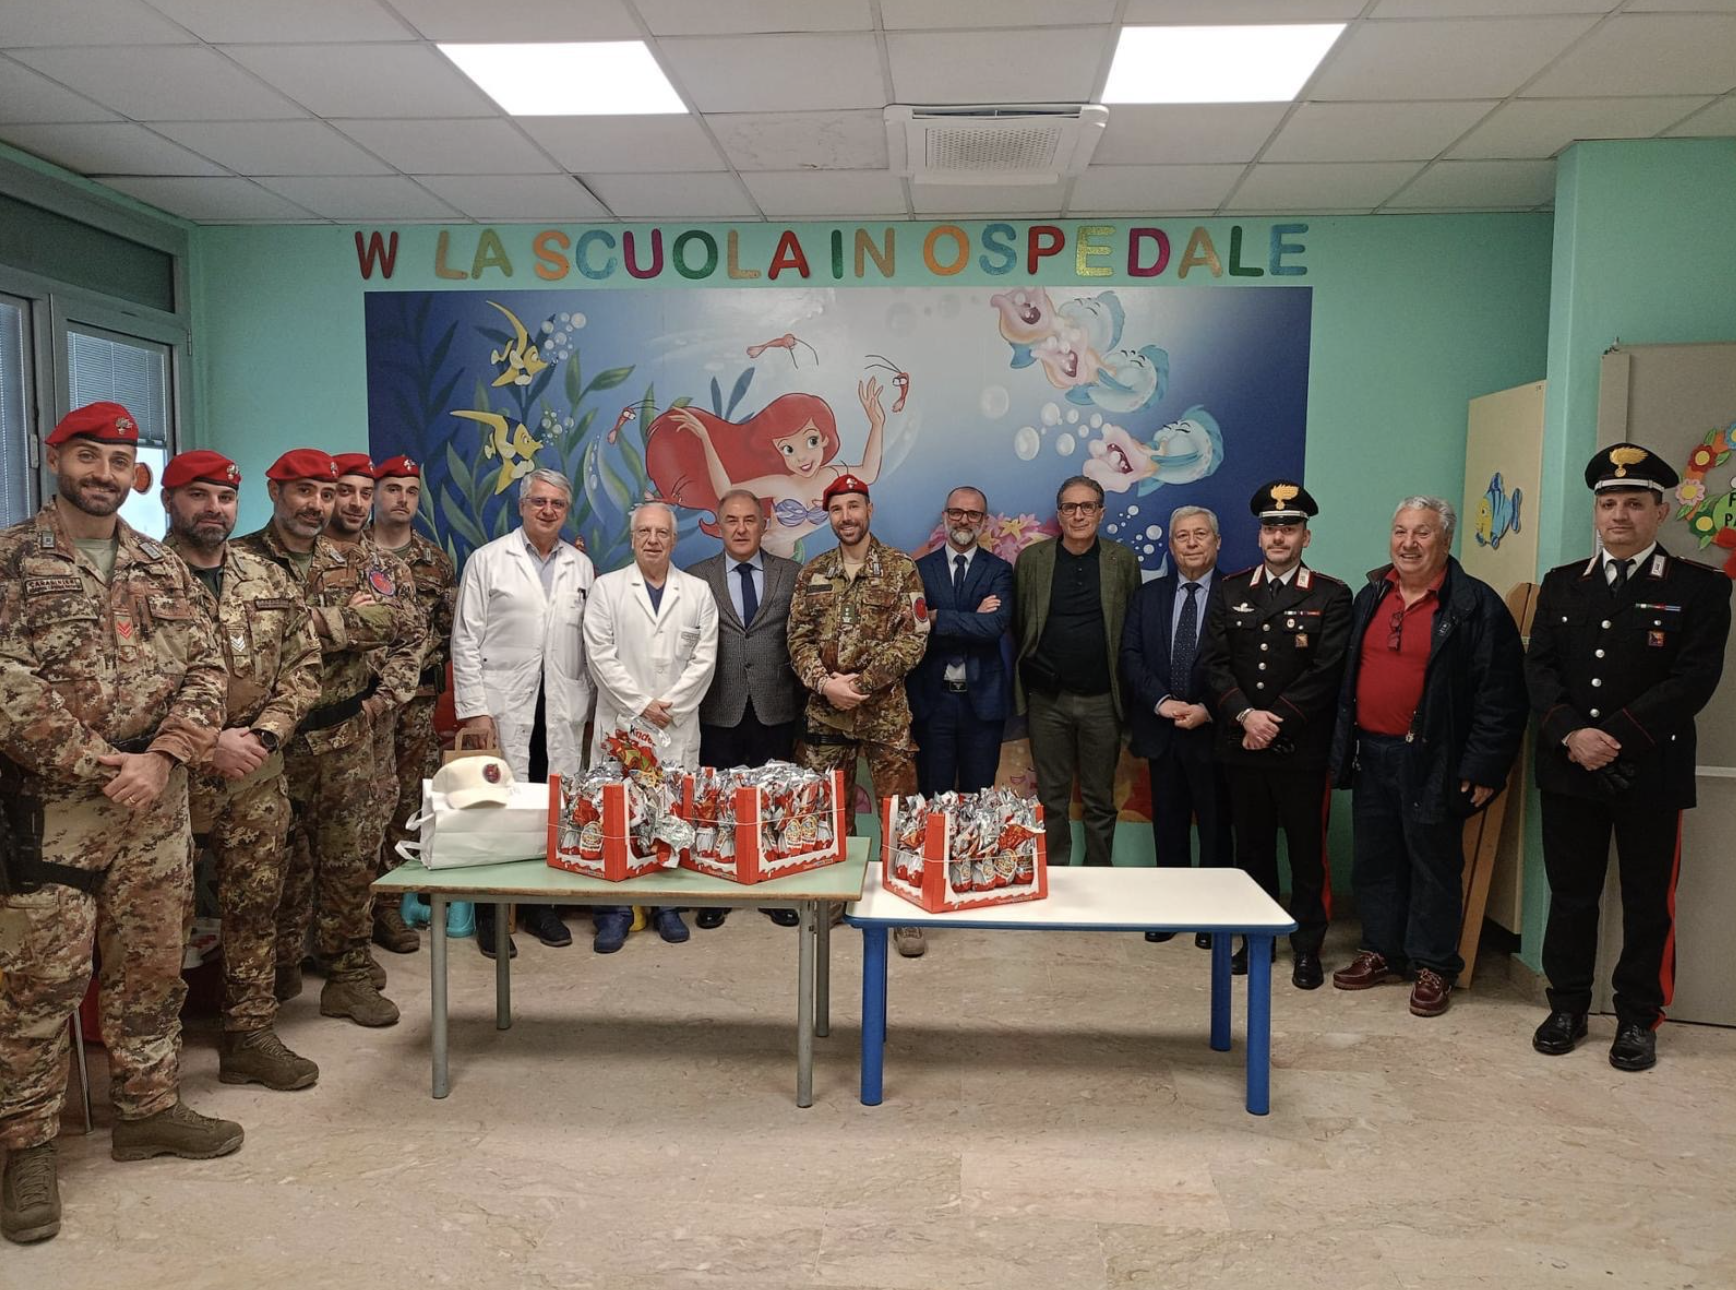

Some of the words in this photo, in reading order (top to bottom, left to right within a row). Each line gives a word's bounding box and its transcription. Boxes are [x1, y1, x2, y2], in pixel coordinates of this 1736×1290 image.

[354, 230, 399, 280] W
[434, 229, 514, 279] LA
[532, 228, 811, 281] SCUOLA
[830, 227, 896, 279] IN
[922, 222, 1310, 279] OSPEDALE
